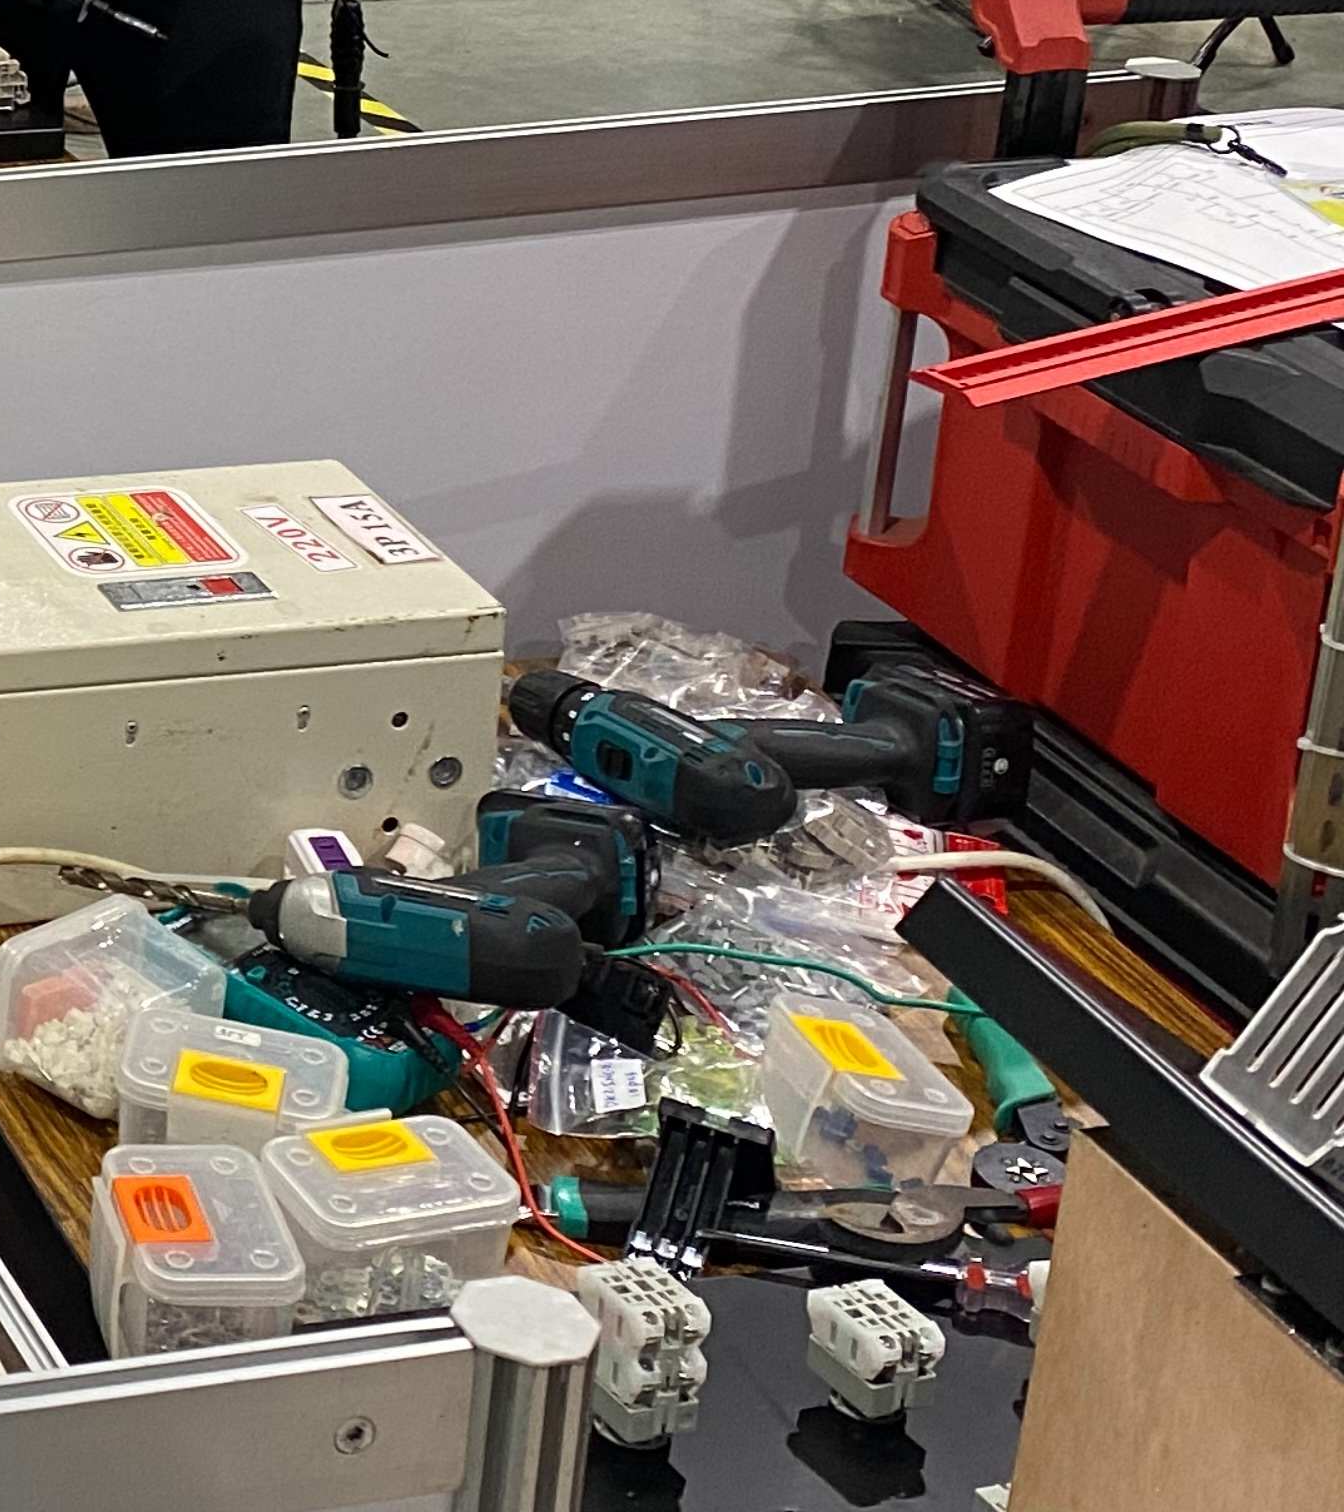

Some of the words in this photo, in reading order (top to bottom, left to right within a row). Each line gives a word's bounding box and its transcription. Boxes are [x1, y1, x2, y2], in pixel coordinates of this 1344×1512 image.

[340, 500, 393, 530] 15A
[260, 516, 340, 563] 220V
[374, 536, 420, 557] 3P
